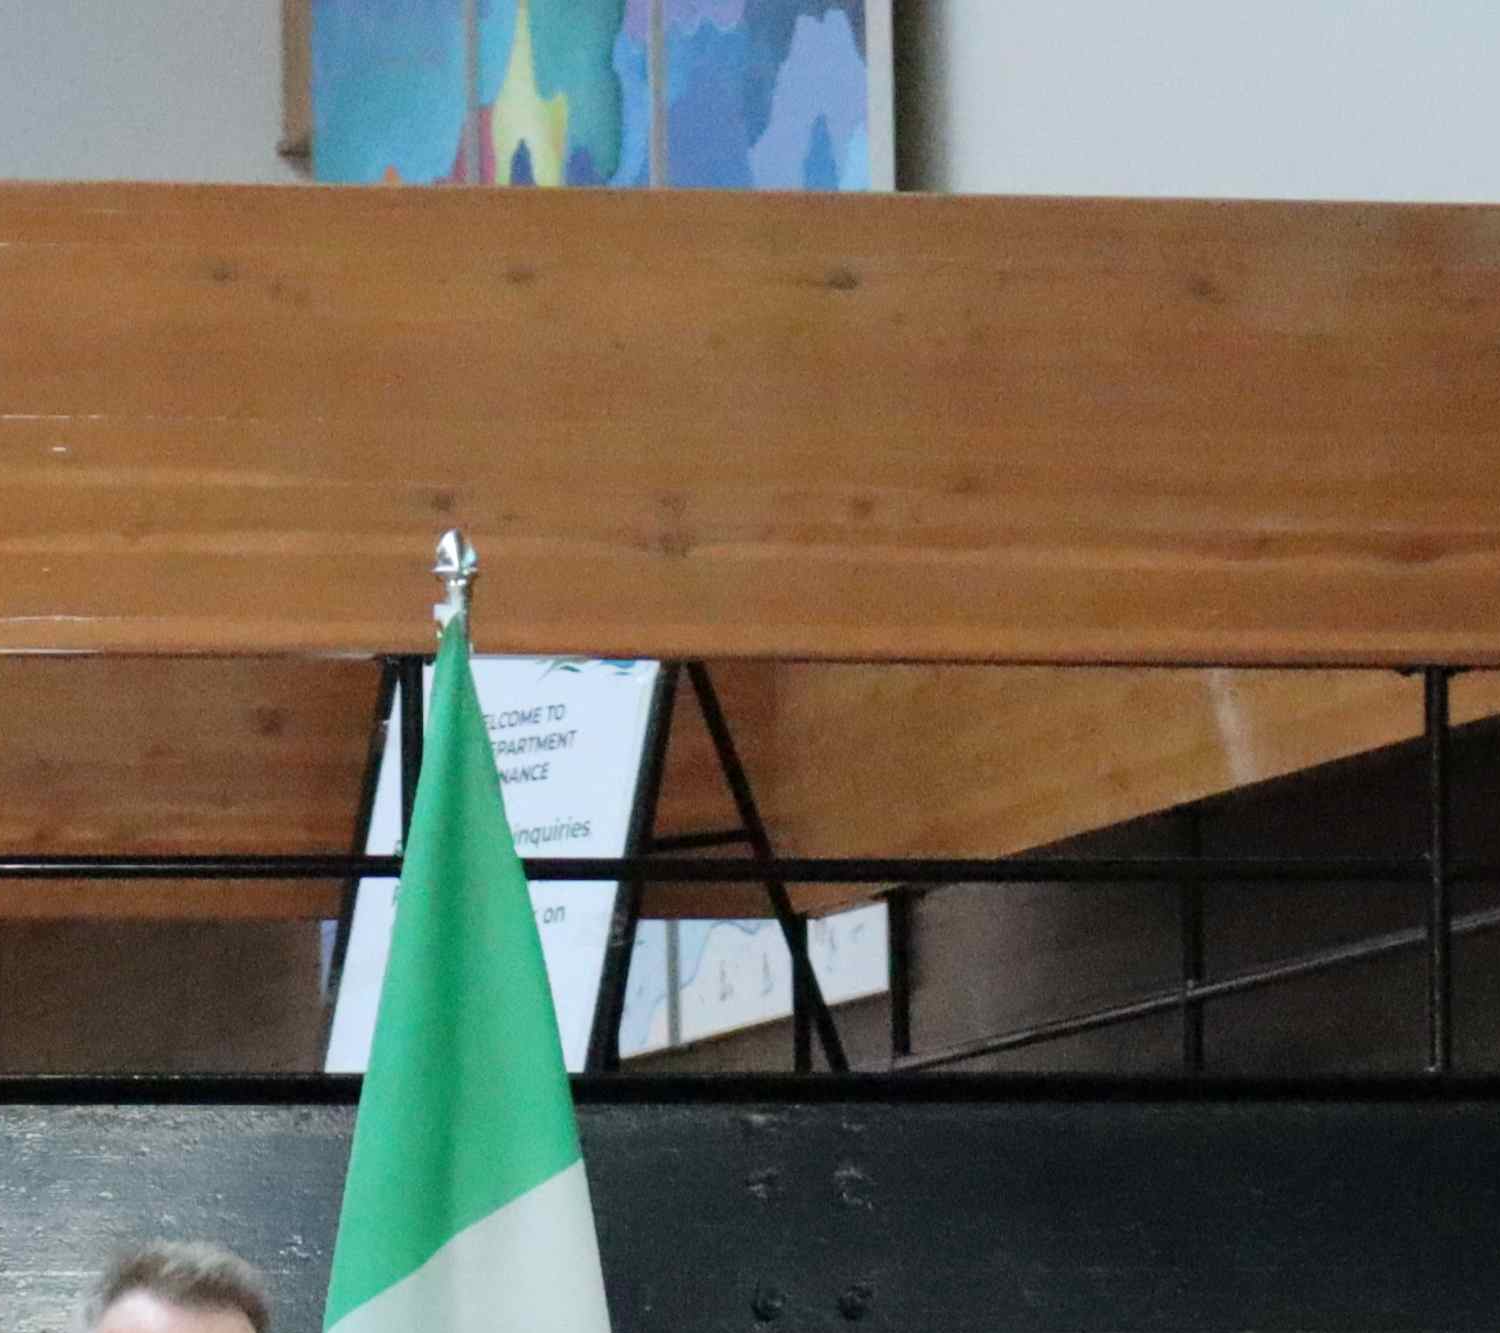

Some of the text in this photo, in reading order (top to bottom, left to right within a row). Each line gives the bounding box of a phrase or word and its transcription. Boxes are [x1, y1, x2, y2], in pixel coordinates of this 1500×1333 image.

[482, 703, 566, 730] ELCOME TO
[490, 730, 577, 755] EPARTMENT
